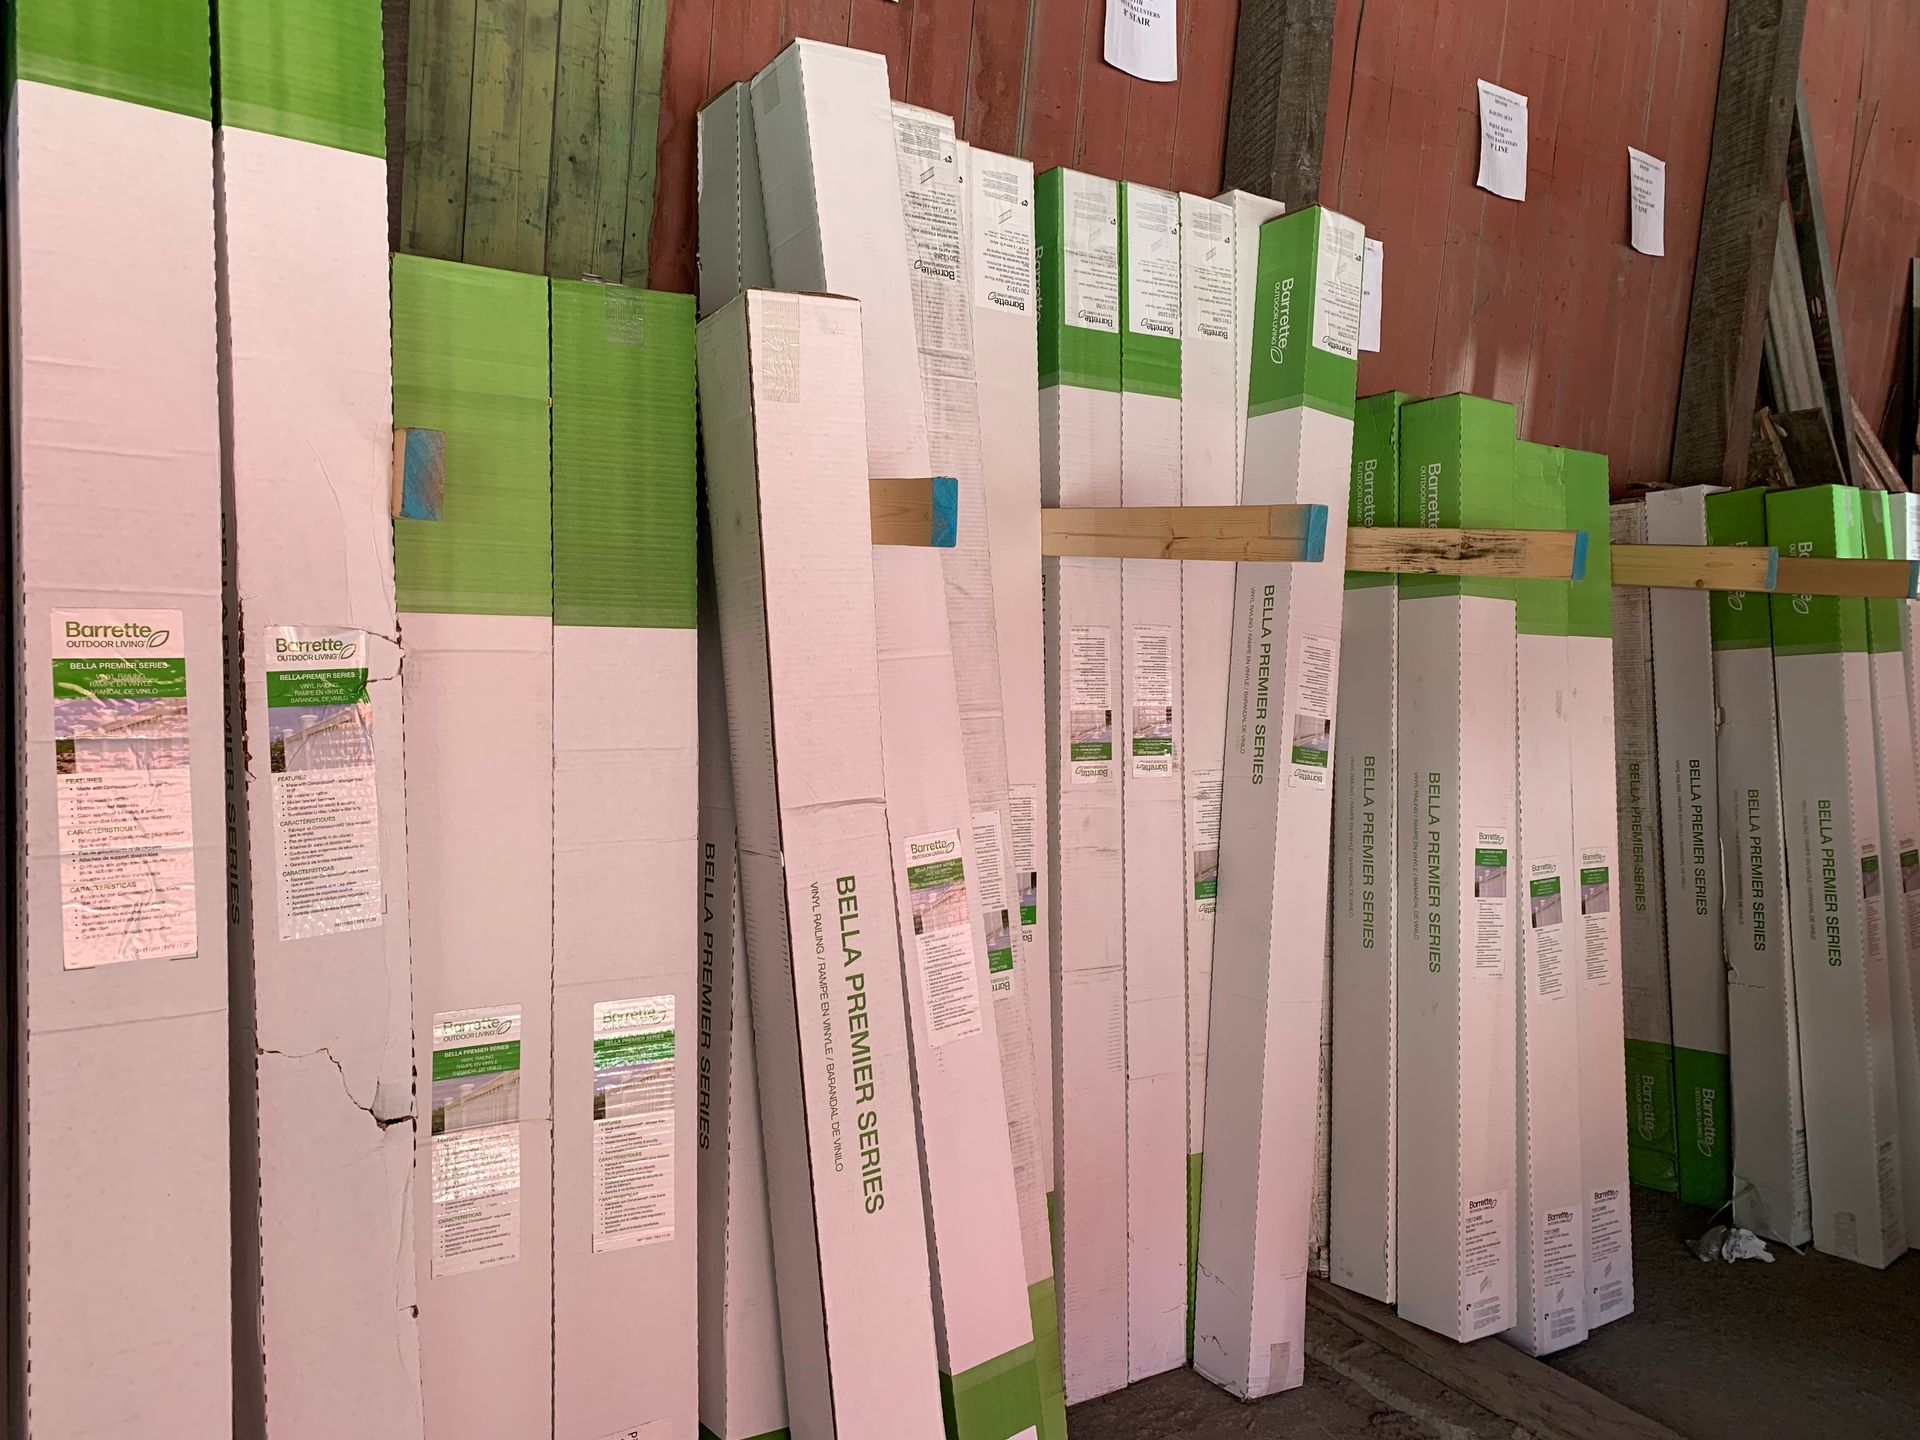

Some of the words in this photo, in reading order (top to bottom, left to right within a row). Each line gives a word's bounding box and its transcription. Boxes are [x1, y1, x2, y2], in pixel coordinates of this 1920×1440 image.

[1129, 4, 1160, 19] BALUSTERS
[1129, 12, 1151, 27] STAIR
[1495, 144, 1509, 154] LINE
[921, 266, 955, 281] Barrette
[994, 297, 1025, 311] Barrette
[1084, 315, 1113, 328] Barrette
[1272, 282, 1280, 324] OUTDOOR
[1279, 278, 1294, 350] Barrette
[1146, 323, 1174, 335] Barrette
[1202, 328, 1228, 340] Barrette
[1328, 340, 1352, 356] Barrette
[1364, 459, 1377, 527] Barrette
[65, 621, 152, 638] Barrette
[1261, 585, 1275, 639] BELLA
[66, 640, 114, 648] OUTDOOR
[116, 640, 145, 648] LIVING
[276, 638, 343, 653] Barrette
[277, 654, 314, 662] OUTDOOR
[314, 653, 338, 661] LIVING
[70, 662, 97, 670] BELLA
[99, 662, 137, 670] PREMIER
[302, 672, 332, 680] PREMIER
[1256, 643, 1271, 720] PREMIER
[1081, 769, 1108, 778] Barrette
[1142, 764, 1168, 772] Barrette
[1252, 724, 1266, 785] SERIES
[66, 777, 103, 785] FEATURES
[1298, 773, 1323, 784] Barrette
[1364, 756, 1375, 807] BELLA
[1630, 764, 1640, 803] BELLA
[1689, 760, 1700, 801] BELLA
[1428, 772, 1441, 826] BELLA
[1748, 789, 1760, 832] BELLA
[1479, 832, 1500, 840] Barrette
[1631, 806, 1644, 864] PREMIER
[1691, 805, 1705, 865] PREMIER
[1818, 800, 1833, 845] BELLA
[226, 802, 240, 925] SERIES
[910, 839, 947, 855] Barrette
[1362, 812, 1374, 886] PREMIER
[703, 843, 715, 924] BELLA
[1428, 831, 1440, 908] PREMIER
[1532, 864, 1552, 873] Barrette
[1750, 836, 1764, 899] PREMIER
[1822, 849, 1838, 913] PREMIER
[810, 881, 821, 912] VINYL
[1634, 865, 1646, 912] SERIES
[1695, 869, 1708, 915] SERIES
[814, 914, 824, 954] RAILING
[836, 875, 862, 968] BELLA
[1362, 890, 1374, 949] SERIES
[1753, 902, 1766, 951] SERIES
[1429, 912, 1441, 973] SERIES
[1826, 916, 1842, 967] SERIES
[700, 932, 714, 1048] PREMIER
[817, 962, 830, 1000] RAMPE
[992, 981, 1010, 994] Barre
[821, 1002, 830, 1017] EN
[444, 1033, 475, 1042] OUTDOOR
[822, 1018, 834, 1055] VINYLE
[845, 972, 875, 1105] PREMIER
[698, 1052, 712, 1150] SERIES
[826, 1063, 840, 1120] BARANDAL
[1642, 1075, 1656, 1130] Barrette
[832, 1121, 841, 1136] DE
[1702, 1088, 1717, 1145] Barrette
[832, 1138, 844, 1173] VINILO
[857, 1110, 885, 1214] SERIES
[1469, 1198, 1492, 1210] Barrette
[1594, 1190, 1615, 1200] Barrette
[1548, 1212, 1569, 1222] Barrette
